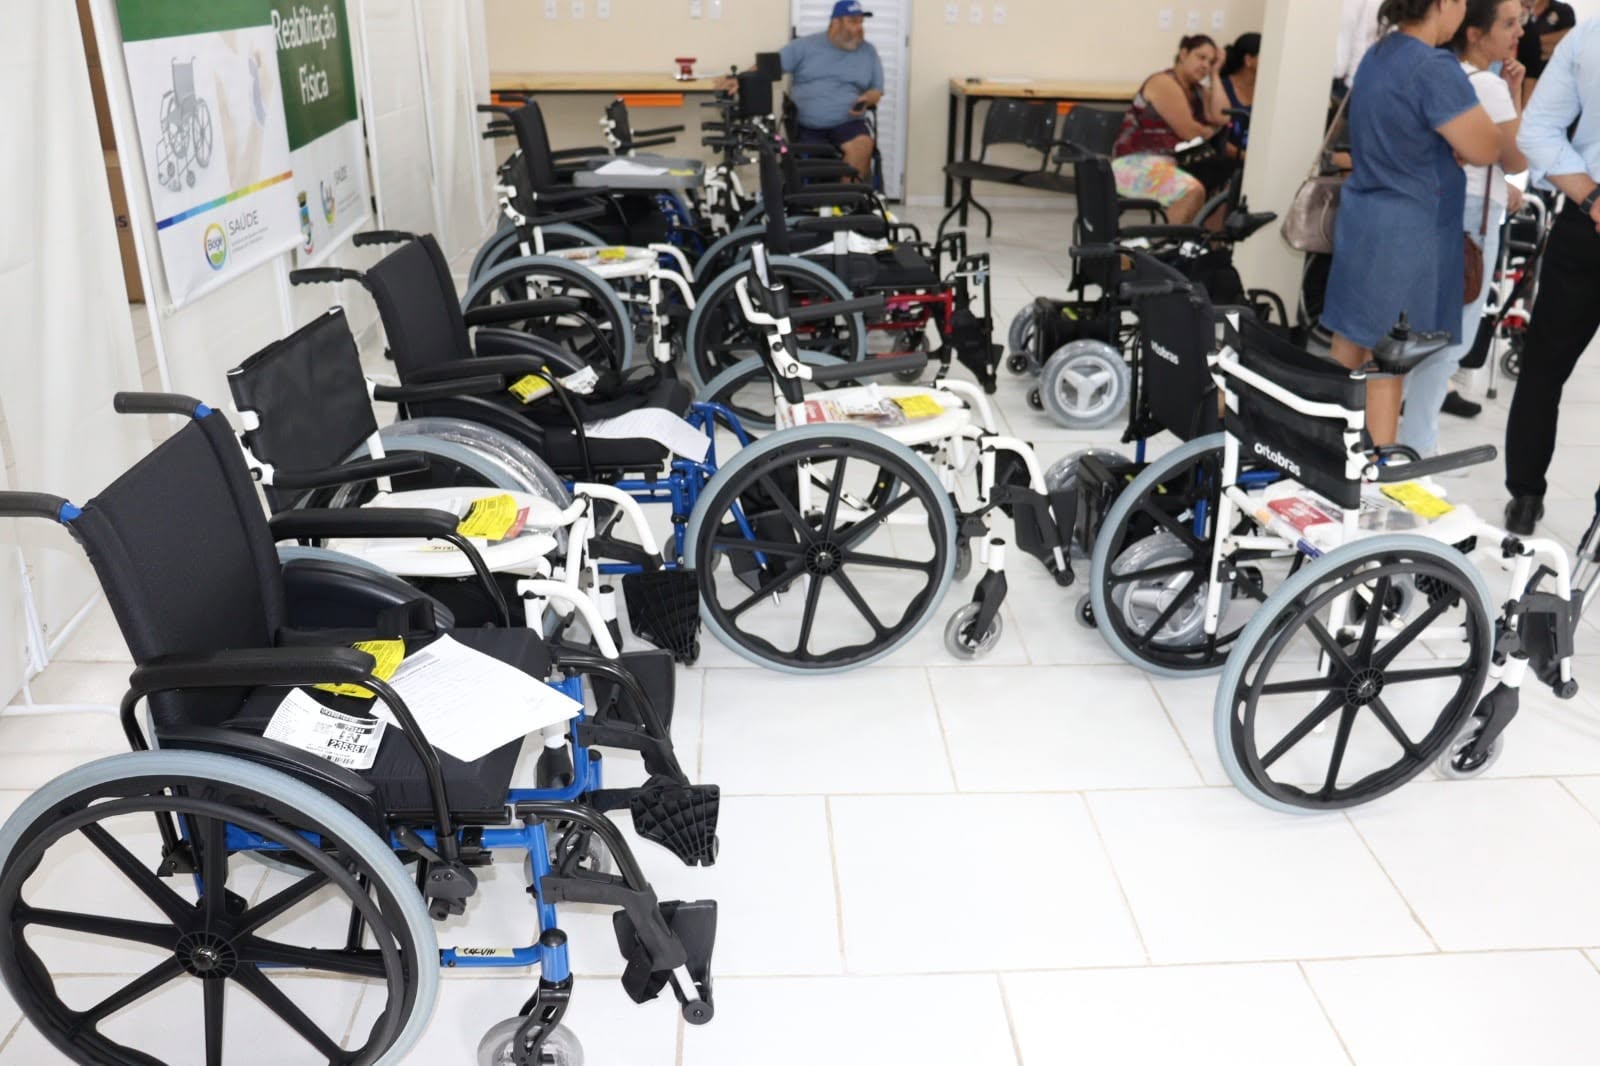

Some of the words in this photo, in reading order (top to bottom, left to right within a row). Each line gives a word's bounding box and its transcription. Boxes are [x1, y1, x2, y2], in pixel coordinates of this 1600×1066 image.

[271, 5, 336, 50] Reabilitação
[299, 63, 329, 105] Física
[228, 209, 259, 236] SAÚDE
[1254, 442, 1301, 477] ortobras
